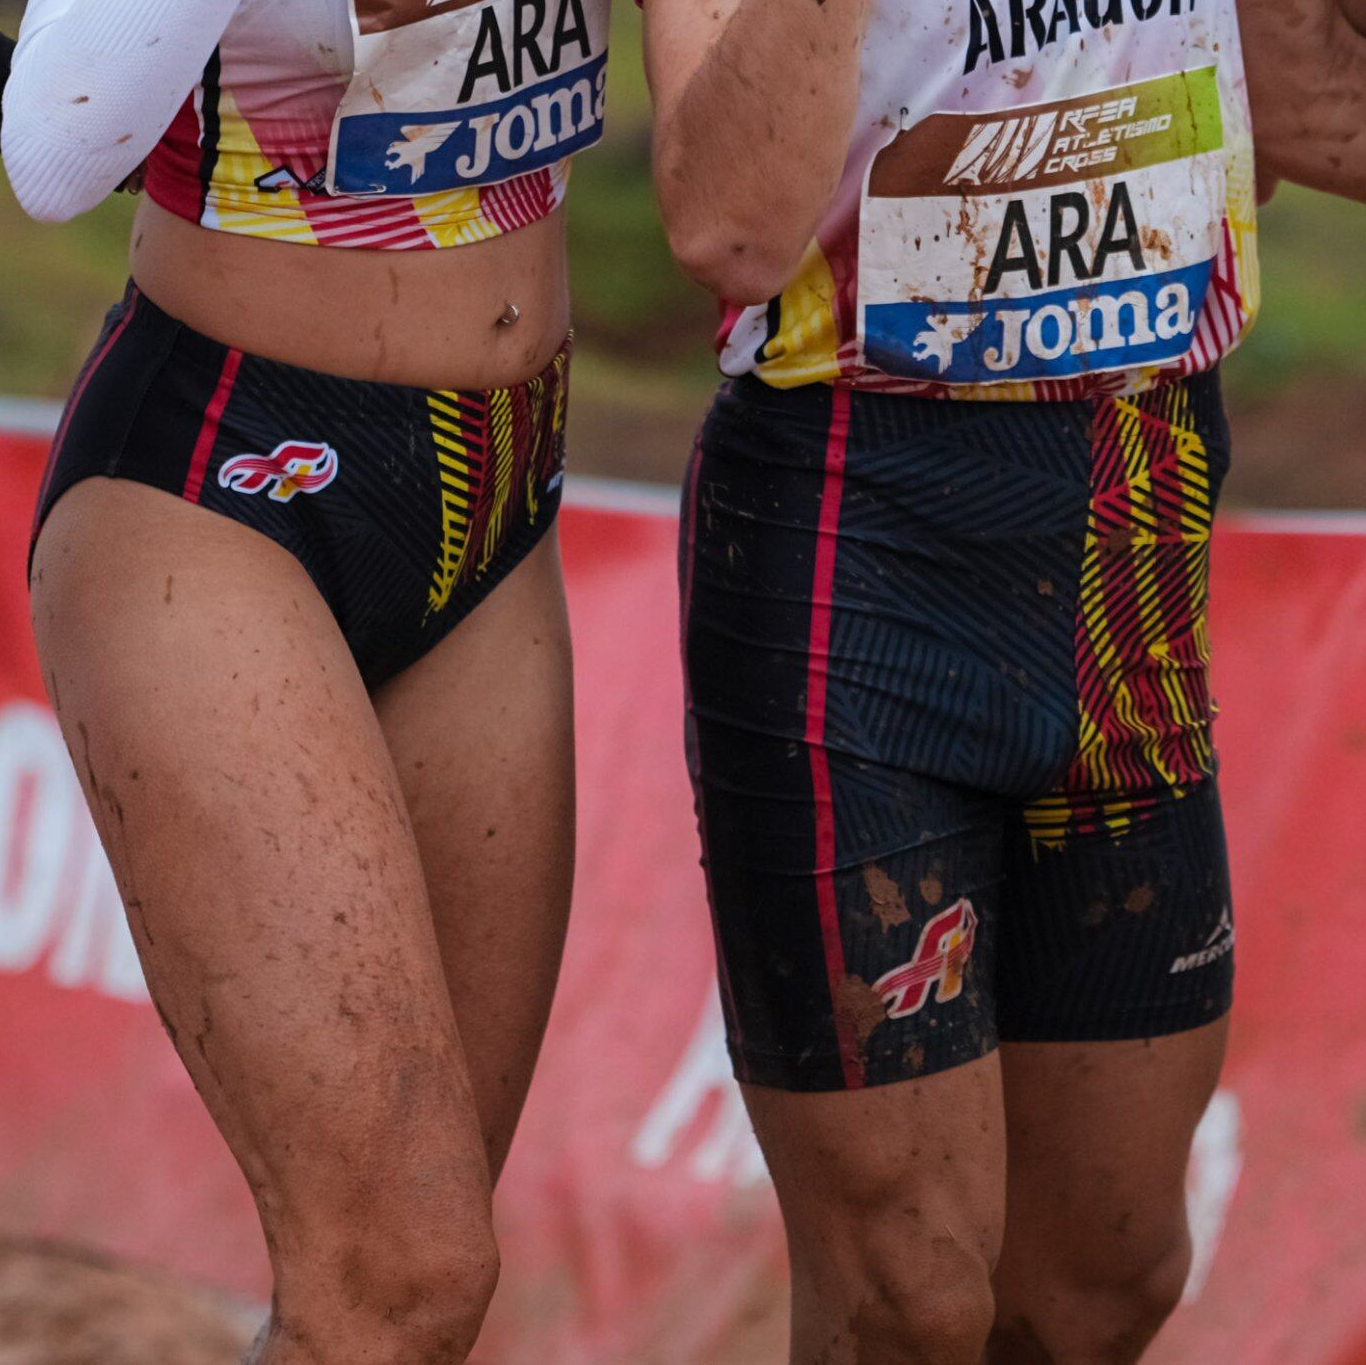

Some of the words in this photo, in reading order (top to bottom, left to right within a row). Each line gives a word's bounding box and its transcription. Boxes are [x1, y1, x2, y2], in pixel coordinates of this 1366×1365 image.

[1059, 96, 1137, 132] RFEA
[1052, 114, 1172, 155] ATLETISMO
[1043, 146, 1117, 174] CROSS
[983, 181, 1146, 295] ARA
